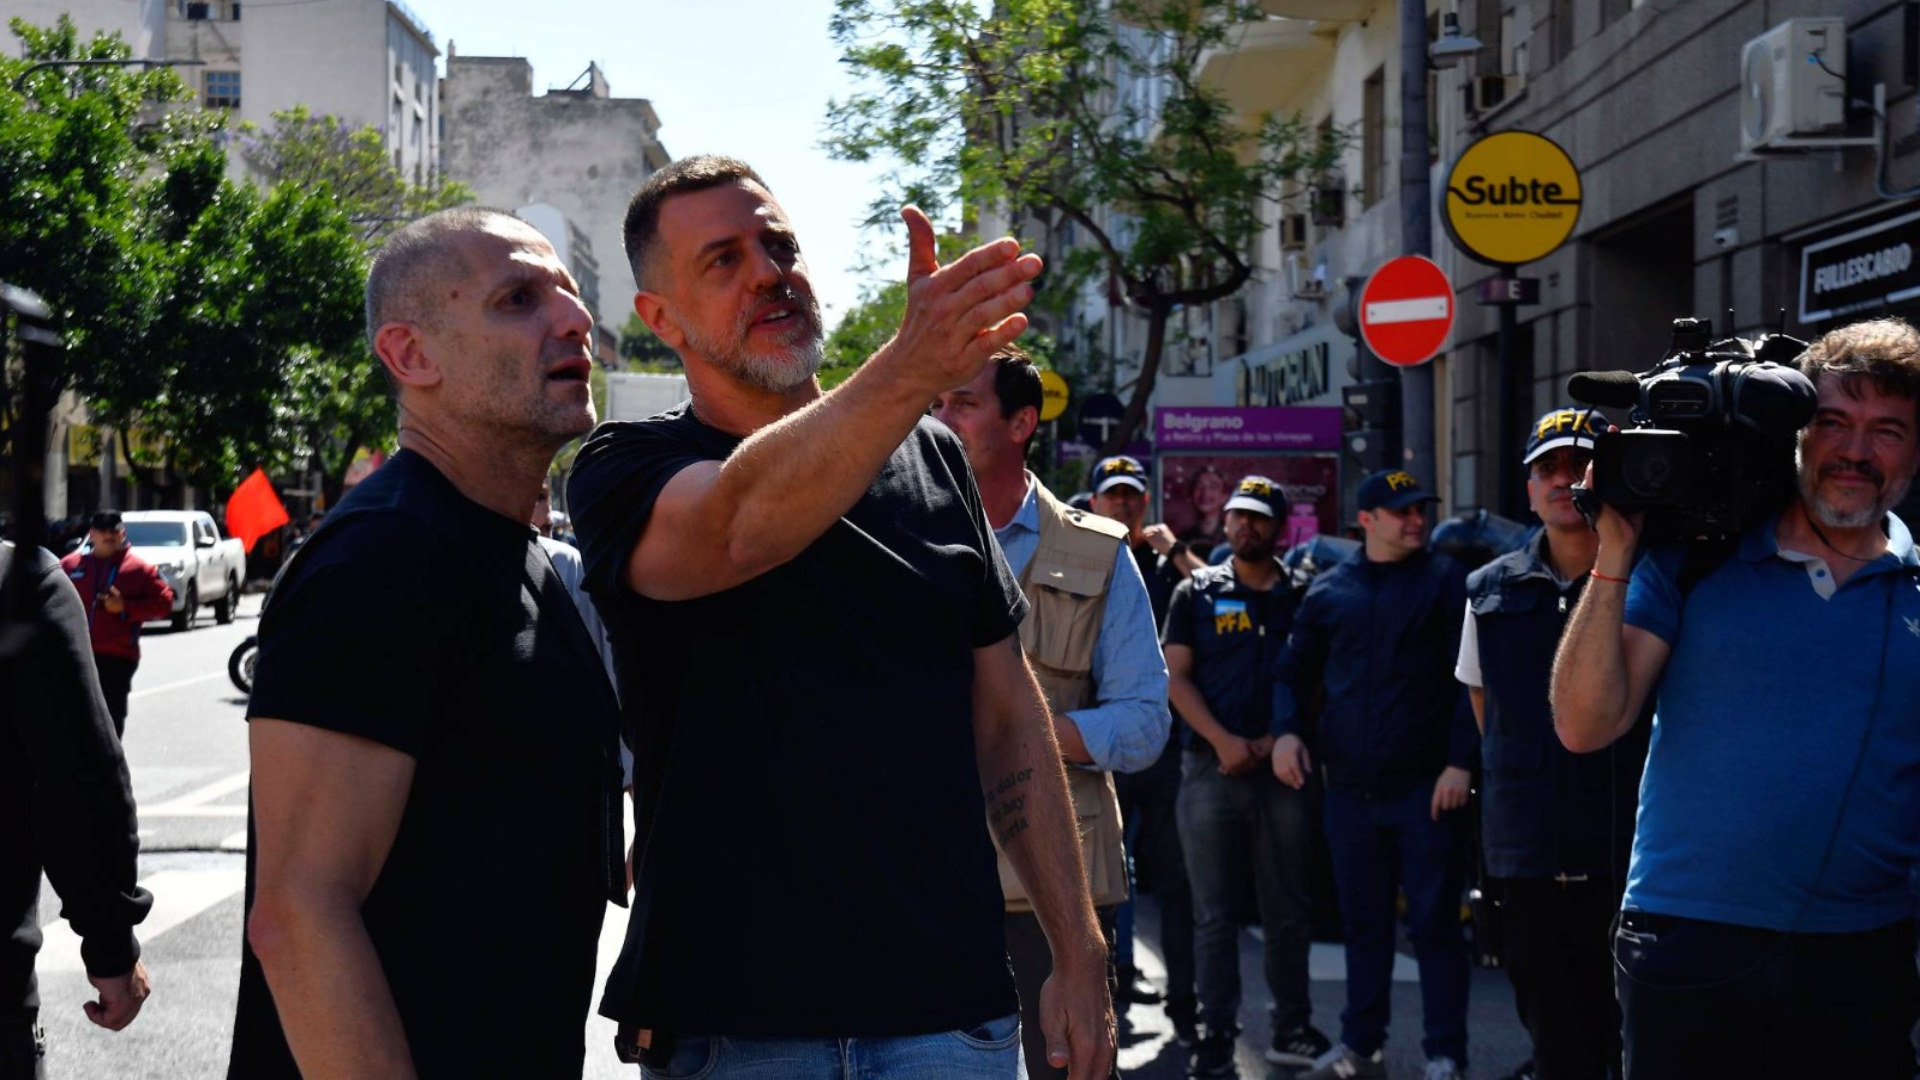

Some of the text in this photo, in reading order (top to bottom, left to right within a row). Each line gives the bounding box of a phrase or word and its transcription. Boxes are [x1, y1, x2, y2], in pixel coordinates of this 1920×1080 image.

[1464, 175, 1562, 206] Subte
[1508, 279, 1522, 299] E
[1163, 412, 1244, 433] Belgrano
[1215, 611, 1252, 636] PFA
[997, 766, 1034, 794] dolor
